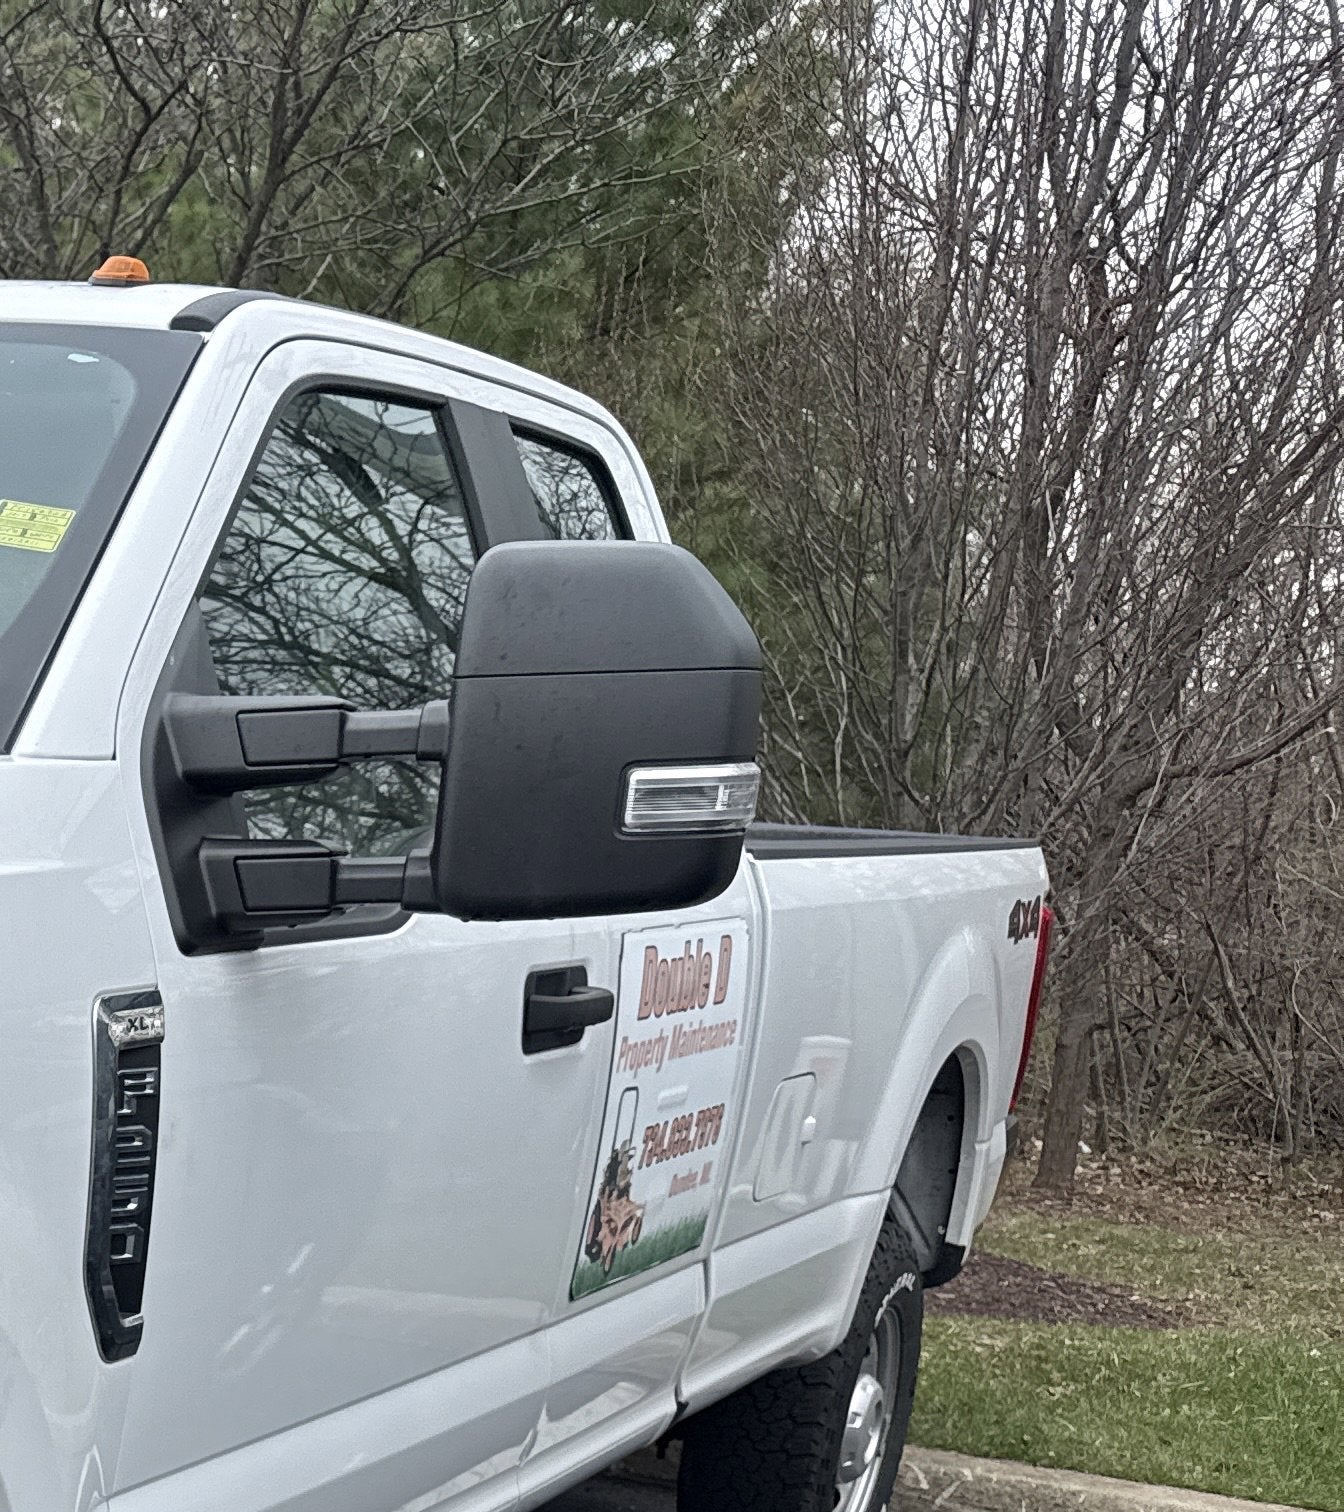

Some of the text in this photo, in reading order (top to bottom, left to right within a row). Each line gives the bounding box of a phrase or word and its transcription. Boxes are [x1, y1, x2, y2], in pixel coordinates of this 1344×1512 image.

[637, 934, 733, 1021] Double D
[616, 1019, 738, 1079] Property Maintenance
